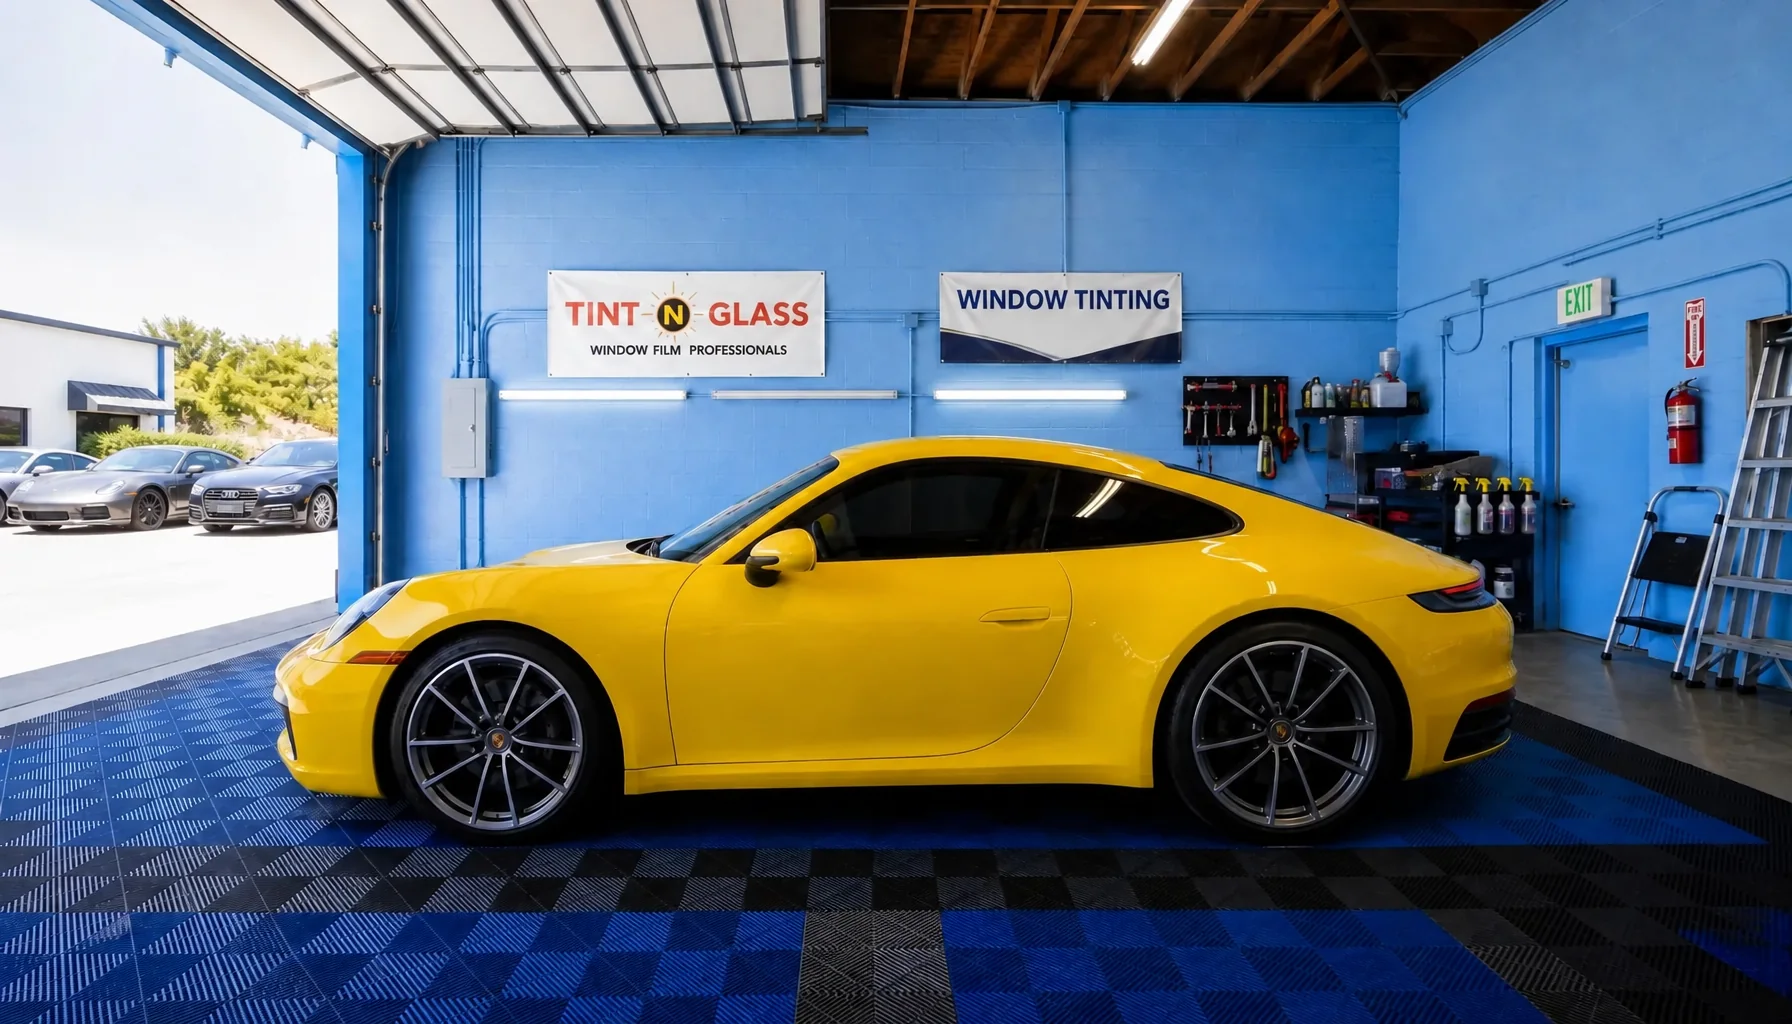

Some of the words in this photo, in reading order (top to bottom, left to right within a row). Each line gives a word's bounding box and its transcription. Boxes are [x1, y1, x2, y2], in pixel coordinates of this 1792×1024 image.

[957, 289, 1068, 310] WINDOW
[1074, 289, 1170, 310] TINTING
[1565, 283, 1593, 317] EXIT
[565, 301, 640, 326] TINT
[663, 304, 684, 325] N
[708, 301, 809, 327] GLASS
[590, 345, 648, 356] WINDOW
[653, 345, 681, 355] FILM
[689, 345, 788, 356] PROFESSIONALS
